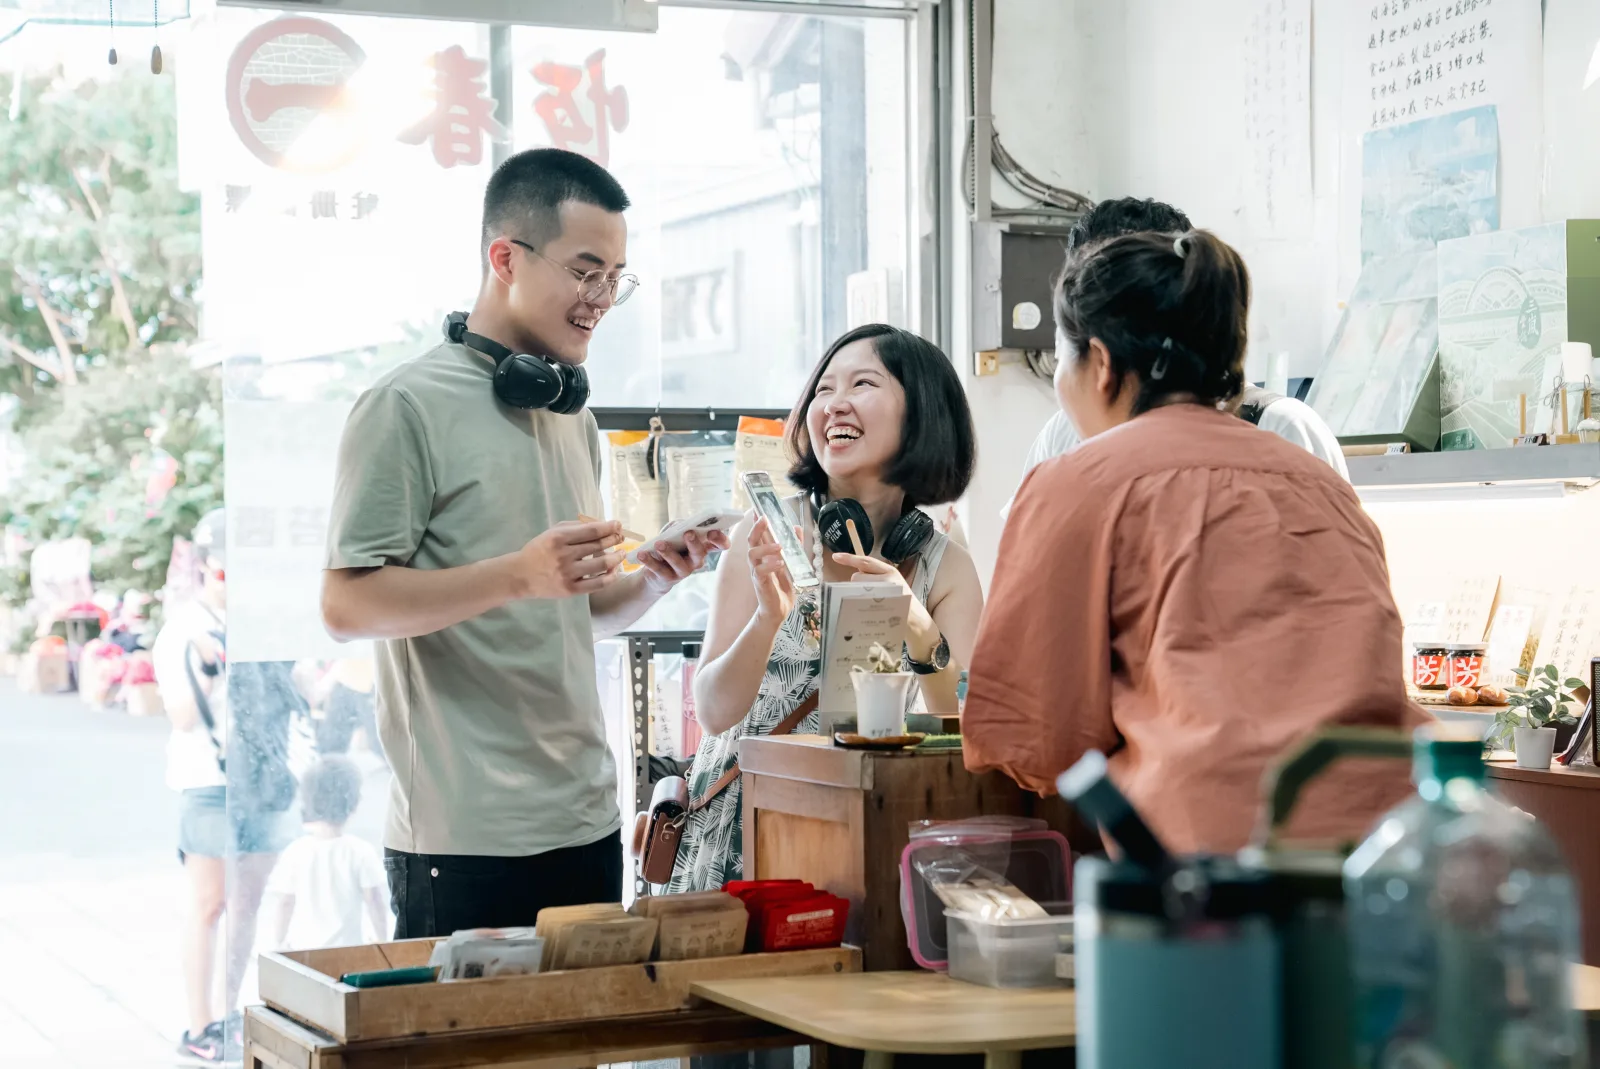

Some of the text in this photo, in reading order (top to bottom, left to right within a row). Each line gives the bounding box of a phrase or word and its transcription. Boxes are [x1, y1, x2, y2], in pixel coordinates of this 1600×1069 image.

[824, 519, 842, 540] SKYLINE
[830, 529, 842, 543] FILM
[1416, 655, 1439, 686] 芳
[1454, 655, 1480, 687] 芳
